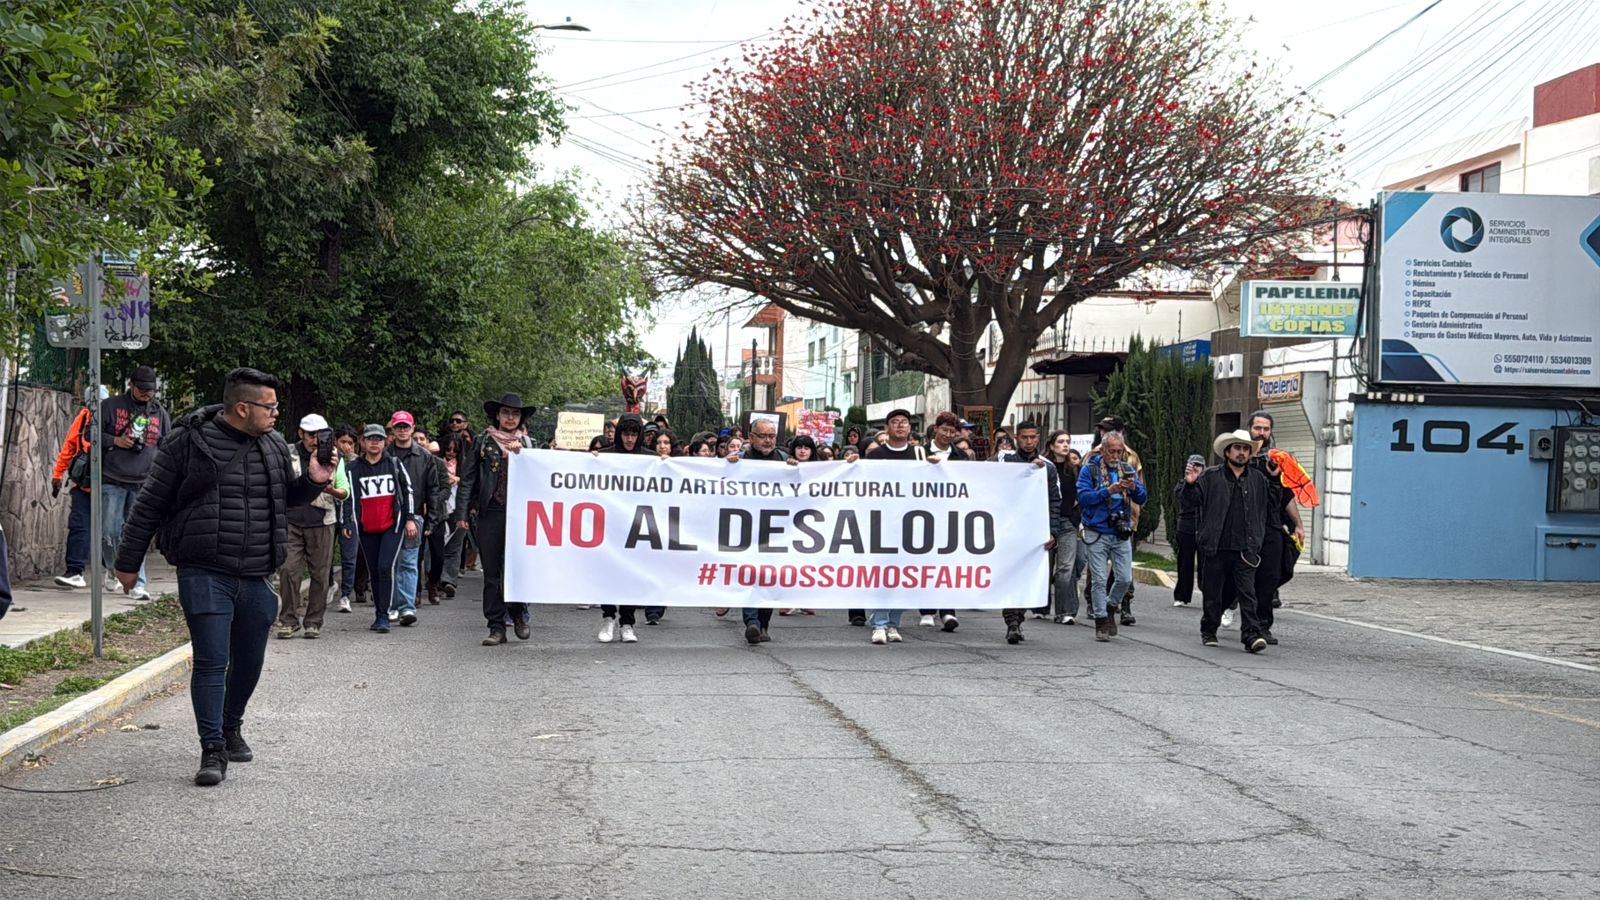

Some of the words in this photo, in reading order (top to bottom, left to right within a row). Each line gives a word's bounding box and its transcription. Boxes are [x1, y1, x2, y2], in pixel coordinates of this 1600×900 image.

[1489, 220, 1526, 228] SERVICIOS
[1489, 228, 1550, 237] ADMINISTRATIVOS
[1489, 236, 1532, 244] INTEGRALES
[1413, 259, 1441, 267] Servicios
[1442, 260, 1472, 268] Contables
[1413, 269, 1457, 278] Reclutamiento
[1463, 270, 1492, 279] Selección
[1493, 271, 1501, 279] de
[1502, 271, 1529, 280] Personal
[1412, 279, 1436, 288] Nómina
[1255, 286, 1361, 300] PAPELERIA
[1412, 290, 1452, 299] Capacitación
[1259, 303, 1355, 316] INTERNET
[1412, 300, 1431, 308] REPSE
[1411, 311, 1440, 320] Paquetes
[1441, 311, 1449, 319] de
[1450, 311, 1494, 320] Compensación
[1495, 312, 1501, 320] al
[1502, 312, 1529, 321] Personal
[1269, 319, 1345, 333] COPIAS
[1411, 320, 1438, 329] Gestoría
[1438, 321, 1483, 330] Administrativa
[1411, 331, 1436, 340] Seguros
[1437, 331, 1445, 339] de
[1446, 331, 1467, 340] Gastos
[1468, 331, 1493, 340] Médicos
[1521, 333, 1538, 342] Auto,
[1539, 333, 1552, 342] Vida
[1558, 334, 1592, 343] Asistencias
[1503, 354, 1544, 364] 5550724110
[1550, 355, 1592, 365] 5534013309
[1390, 418, 1524, 455] 104
[550, 472, 673, 494] COMUNIDAD
[679, 476, 784, 497] ARTÍSTICA
[789, 482, 802, 497] Y
[808, 481, 906, 498] CULTURAL
[912, 481, 969, 499] UNIDA
[525, 500, 606, 549] NO
[624, 505, 698, 551] AL
[718, 507, 996, 555] DESALOJO
[697, 563, 992, 589] #TODOSSOMOSFAHC
